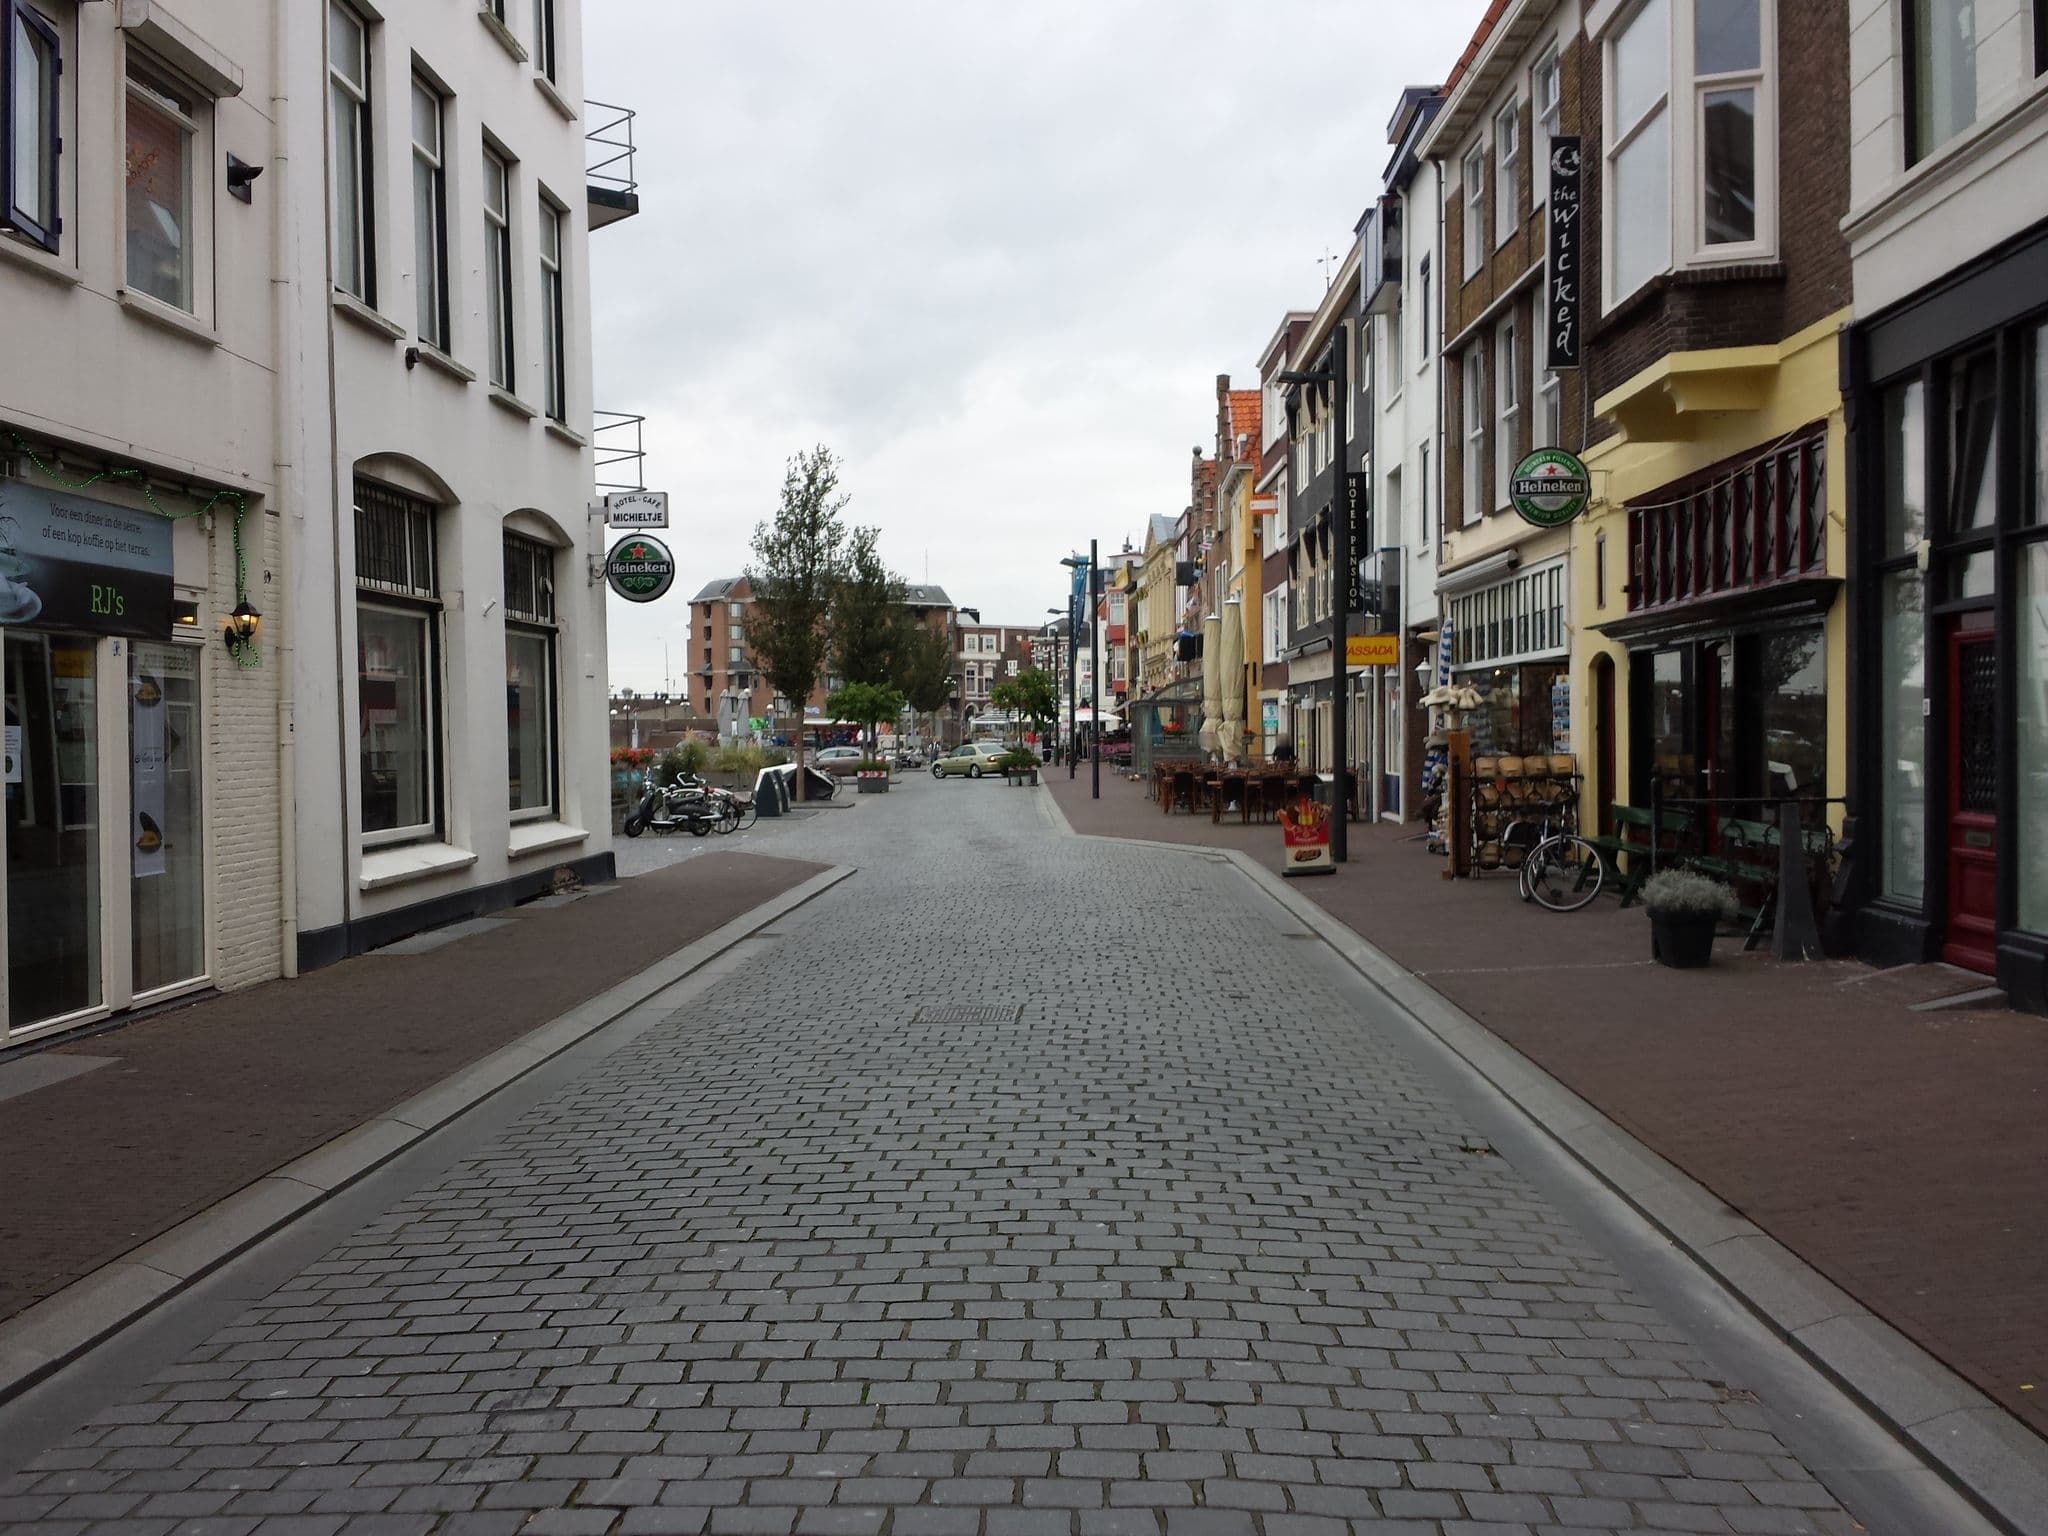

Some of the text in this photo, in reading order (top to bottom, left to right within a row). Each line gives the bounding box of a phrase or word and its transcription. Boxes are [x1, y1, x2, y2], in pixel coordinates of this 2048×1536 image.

[1553, 185, 1577, 201] the
[1519, 480, 1582, 493] Heineken
[613, 496, 637, 510] HOTEL
[50, 503, 68, 520] Voor
[69, 510, 83, 522] een
[104, 514, 113, 528] in
[113, 517, 122, 530] de
[613, 512, 663, 522] MICHIELTJE
[42, 525, 52, 539] of
[52, 530, 66, 541] een
[67, 529, 81, 547] kop
[83, 531, 104, 548] koffie
[105, 540, 115, 552] op
[115, 537, 127, 553] het
[1348, 478, 1358, 608] HOTEL PENSION
[611, 561, 668, 575] Heineken
[91, 584, 124, 616] RJ's
[1346, 645, 1393, 656] ASSADA
